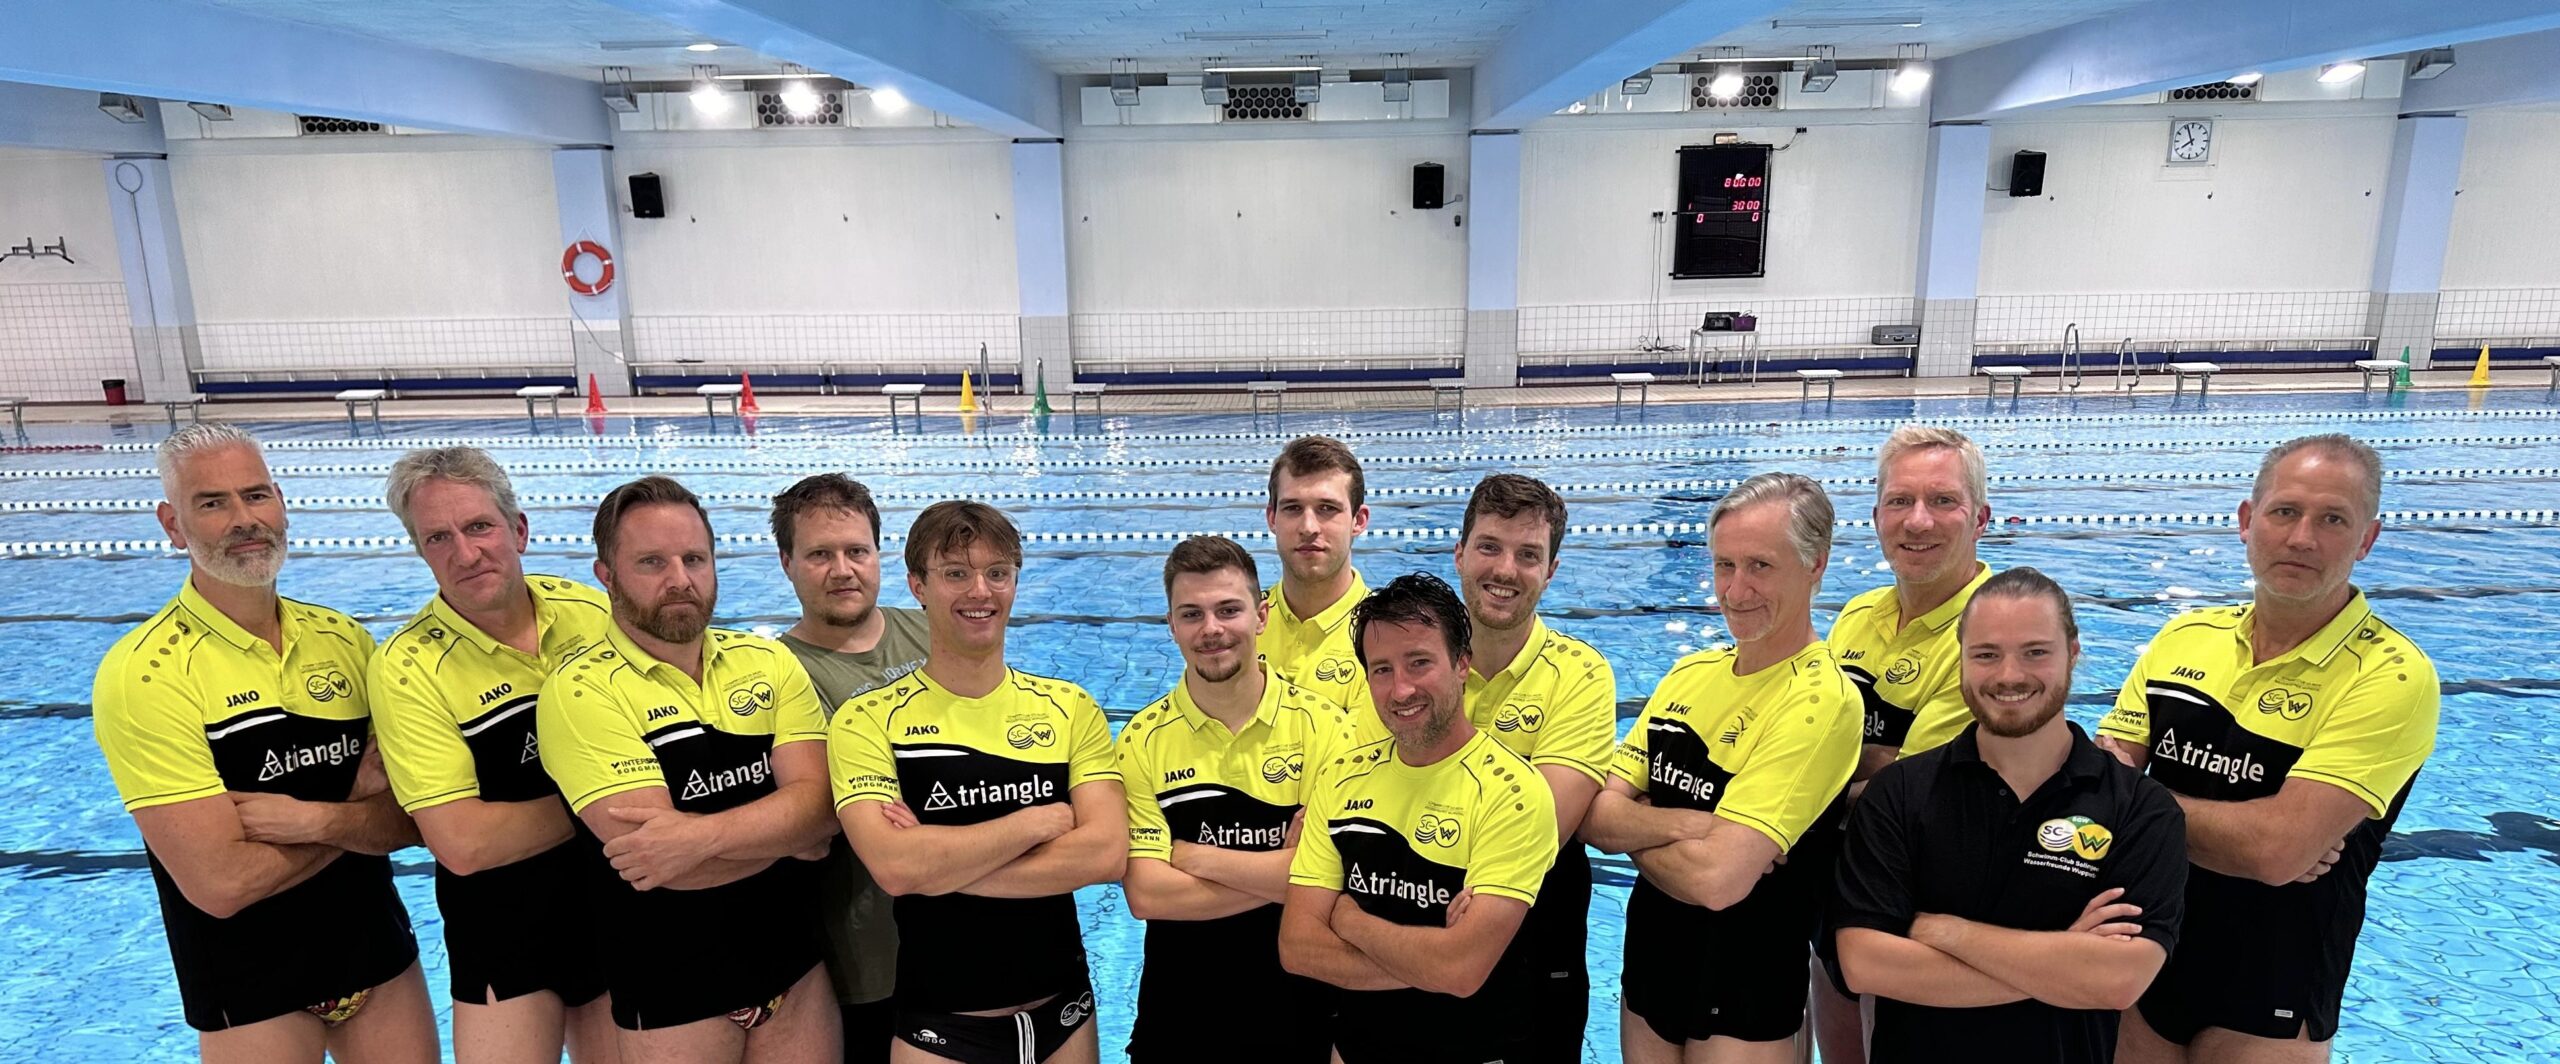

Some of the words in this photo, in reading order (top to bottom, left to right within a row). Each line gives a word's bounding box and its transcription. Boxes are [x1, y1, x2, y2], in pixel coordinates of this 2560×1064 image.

[1697, 213, 1704, 223] 0
[1752, 212, 1759, 222] 0
[2171, 666, 2205, 681] JAKO
[226, 690, 260, 707] JAKO
[479, 683, 512, 705] JAKO
[647, 705, 679, 721] JAKO
[905, 725, 939, 736] JAKO
[2183, 741, 2265, 784] triangle
[1165, 767, 1195, 783] JAKO
[852, 782, 898, 791] BORGMANN
[958, 774, 1053, 804] triangle
[1344, 798, 1374, 810] JAKO
[1218, 821, 1286, 847] triangl
[2078, 831, 2111, 853] W
[2023, 858, 2071, 871] Wasserfreunde
[2027, 851, 2075, 865] Schwimm-Club
[1369, 871, 1450, 909] triangle
[912, 1032, 947, 1045] TURBO
